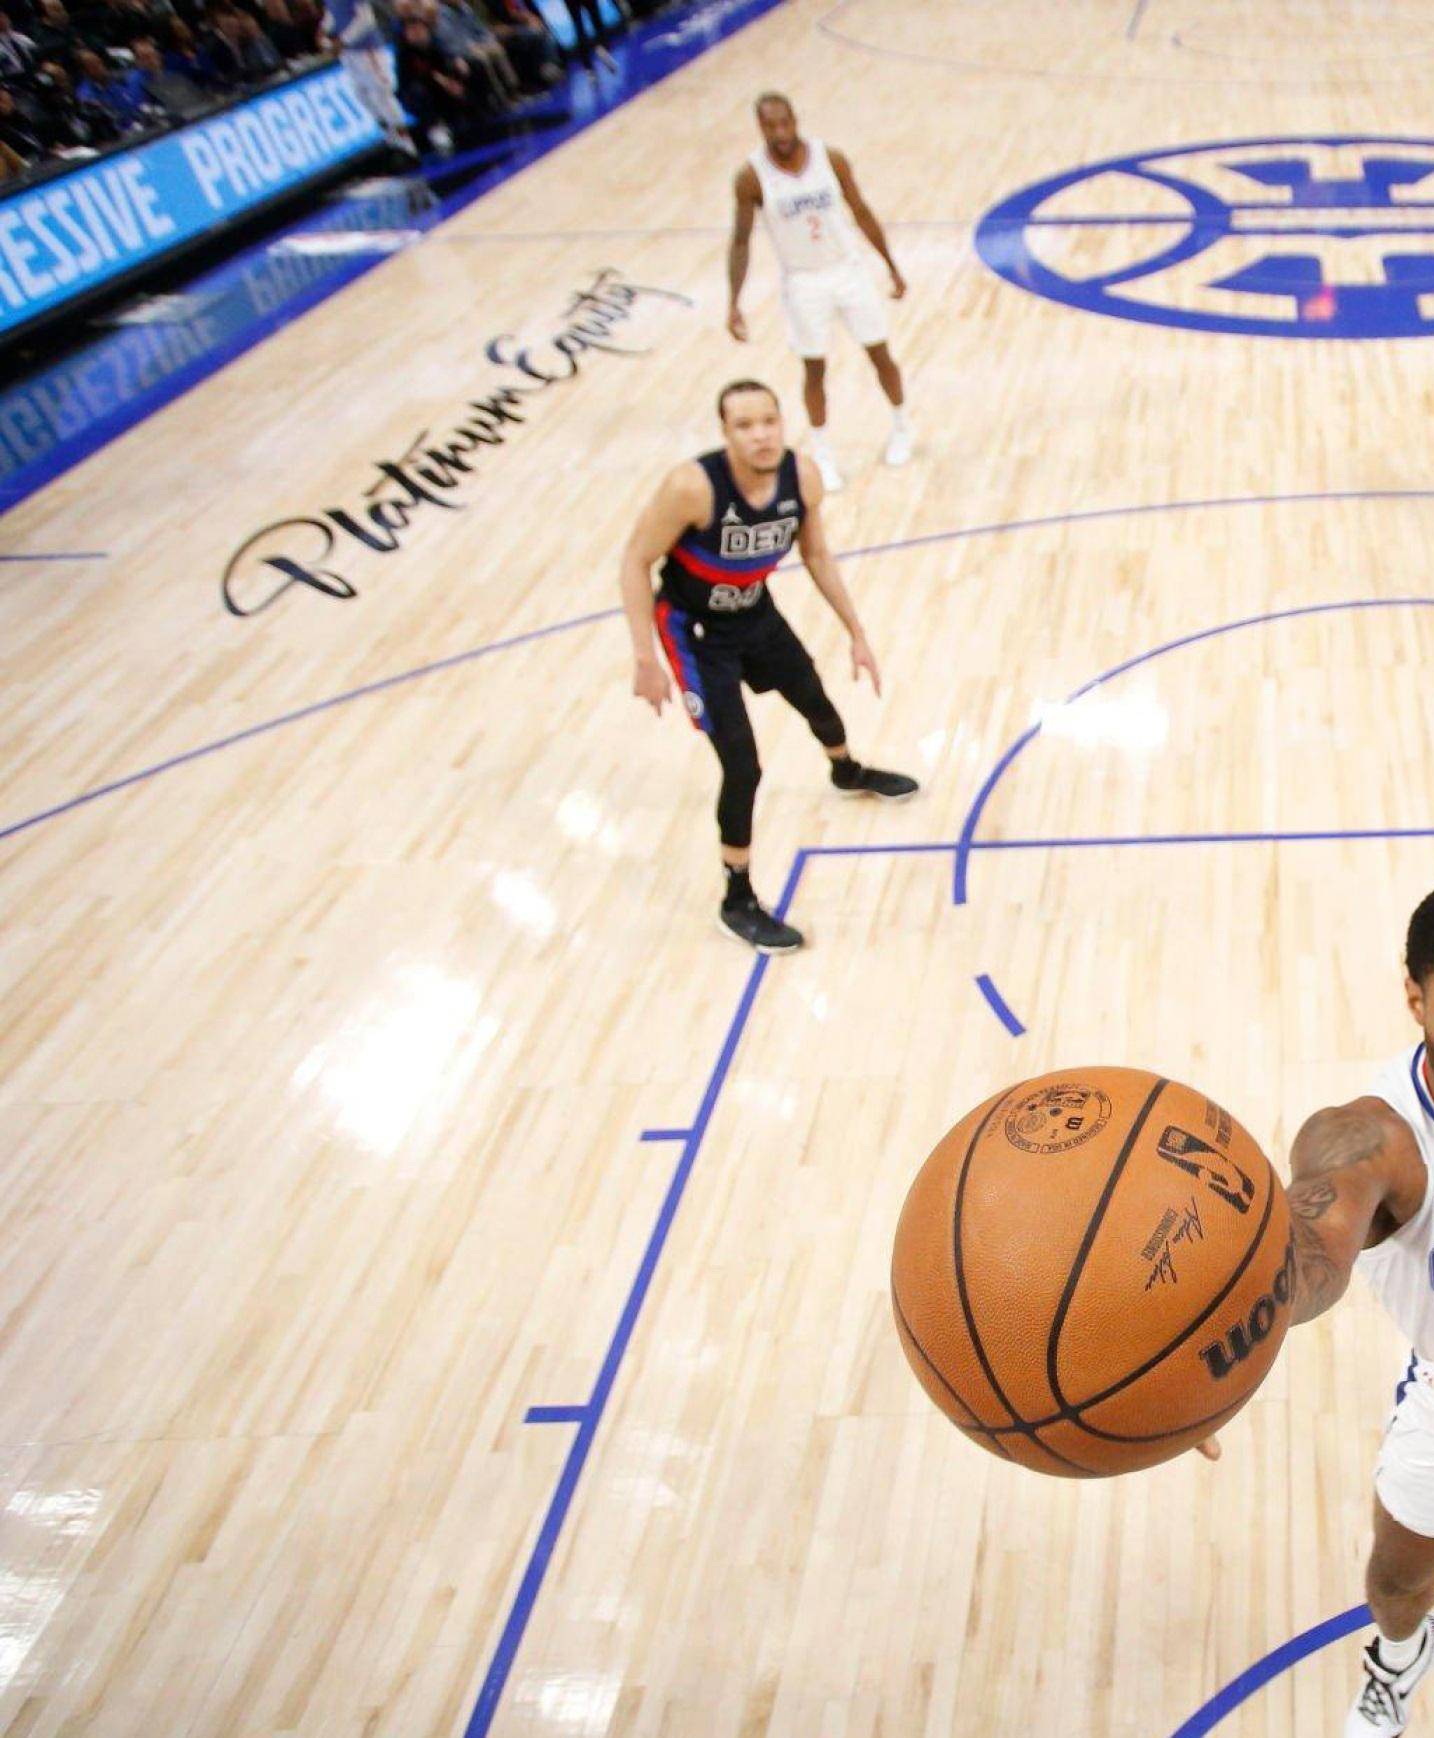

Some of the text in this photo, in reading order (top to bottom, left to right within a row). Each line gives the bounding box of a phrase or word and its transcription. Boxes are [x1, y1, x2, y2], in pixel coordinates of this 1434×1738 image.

[0, 150, 176, 309] ESSIVE
[222, 386, 528, 618] Platinum
[719, 516, 799, 560] DET
